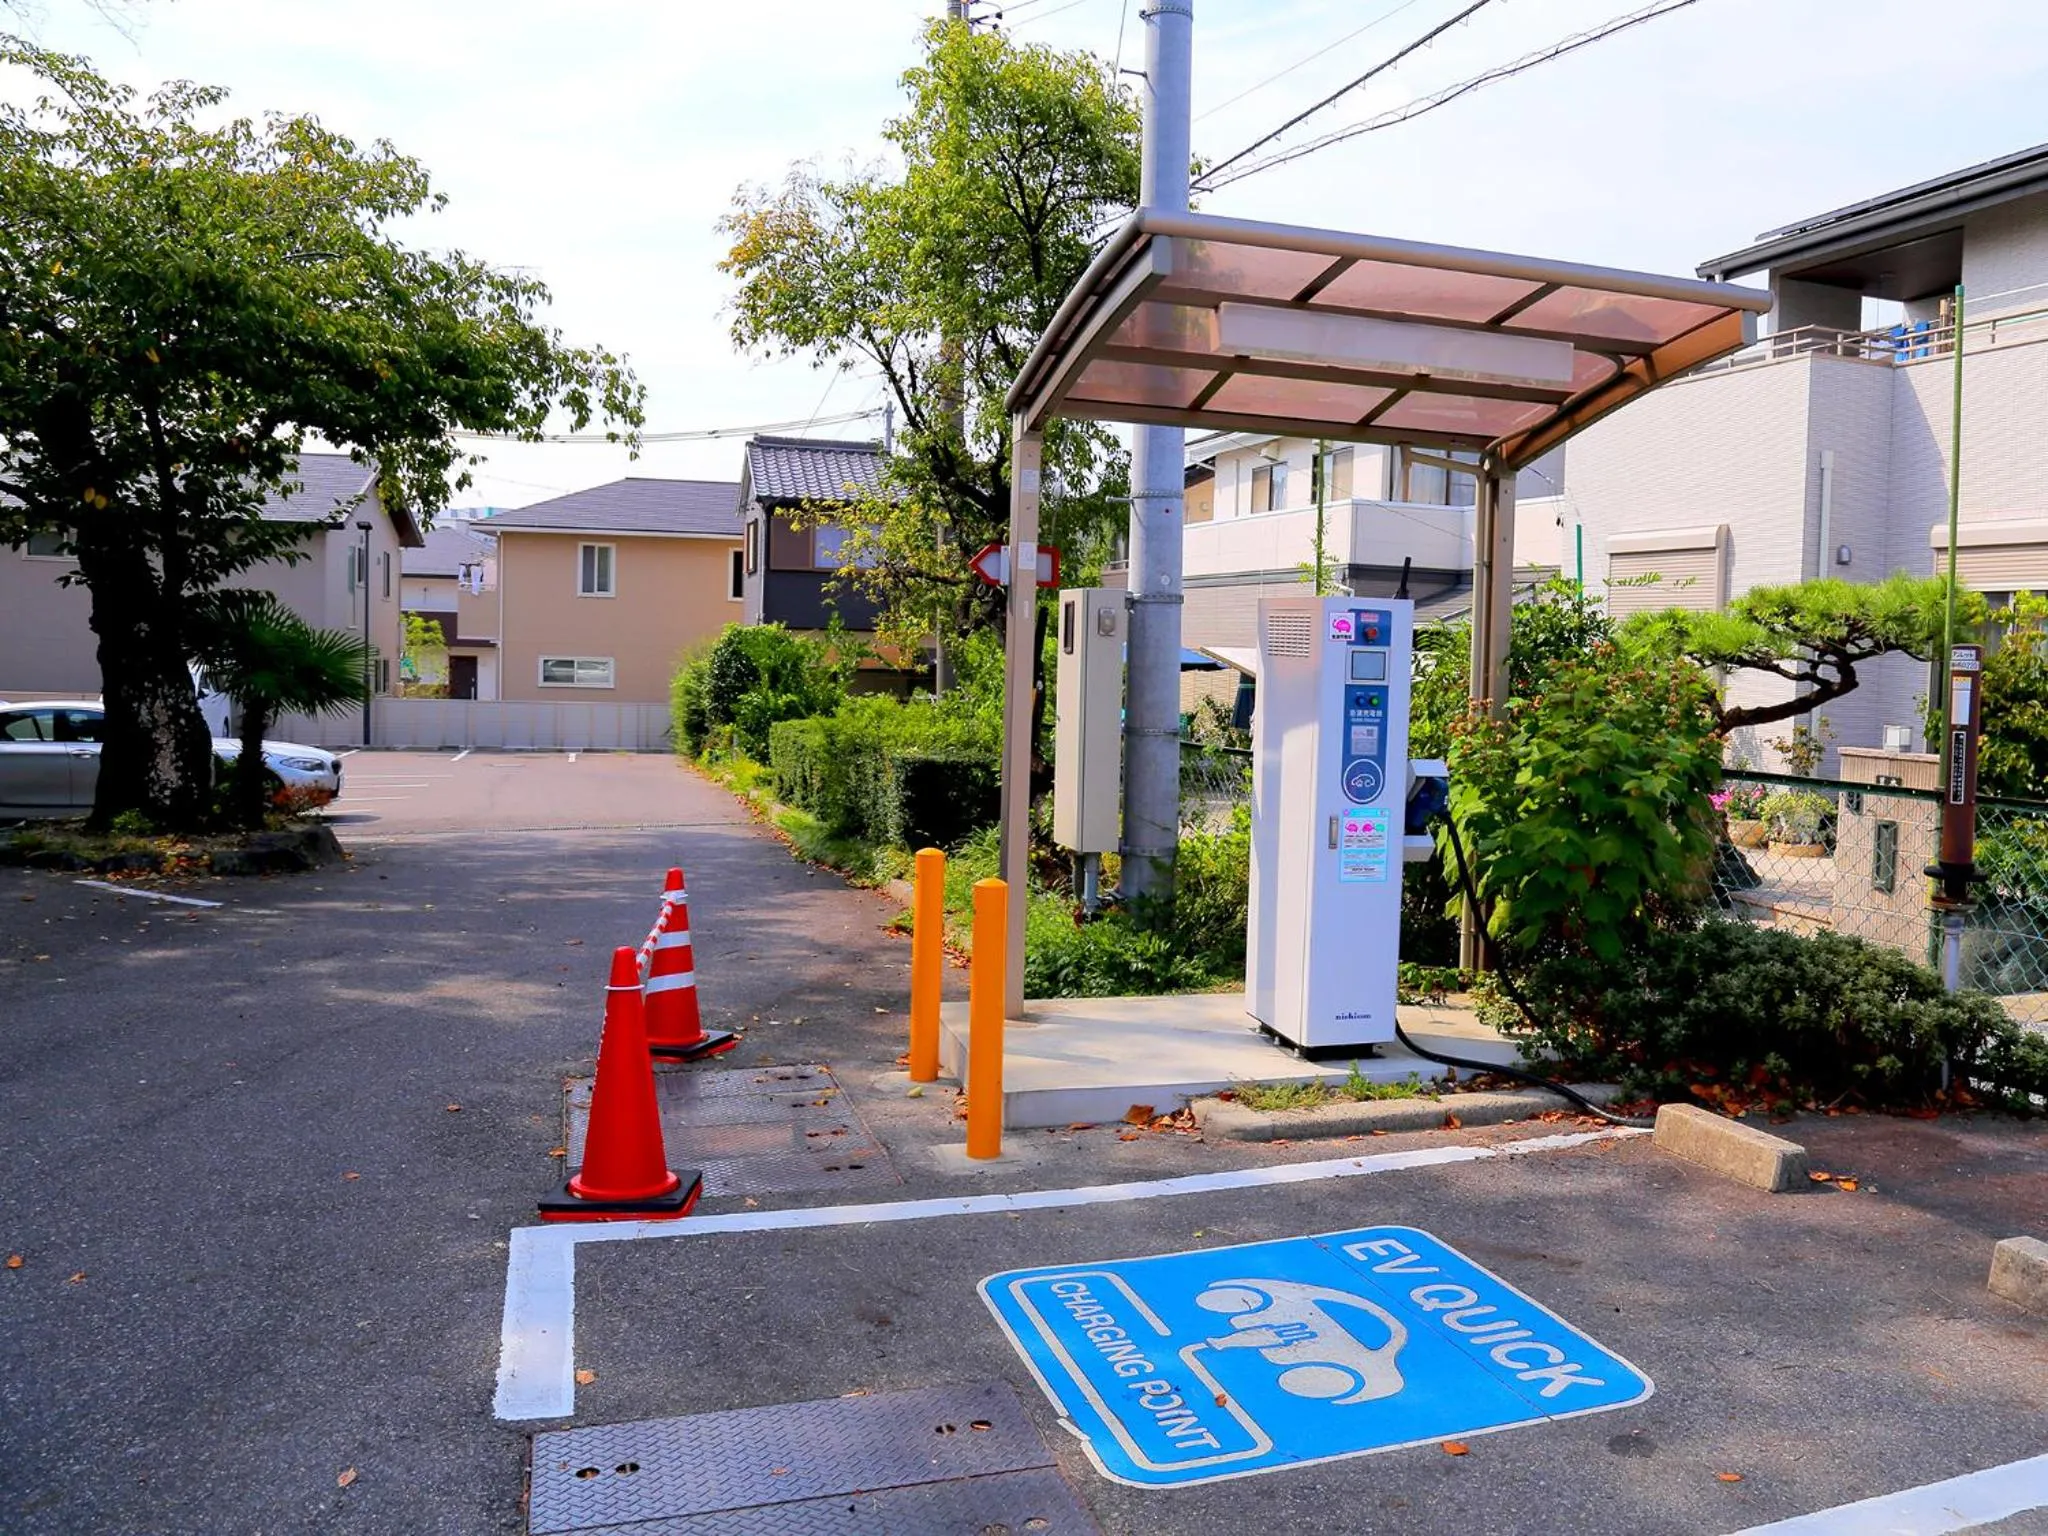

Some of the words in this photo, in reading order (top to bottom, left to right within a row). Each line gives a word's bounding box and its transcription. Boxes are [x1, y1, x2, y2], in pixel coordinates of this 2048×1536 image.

[1051, 1281, 1155, 1377] CHARGING
[1128, 1380, 1221, 1448] POINT
[1342, 1239, 1440, 1274] EV
[1410, 1284, 1605, 1397] QUICK
